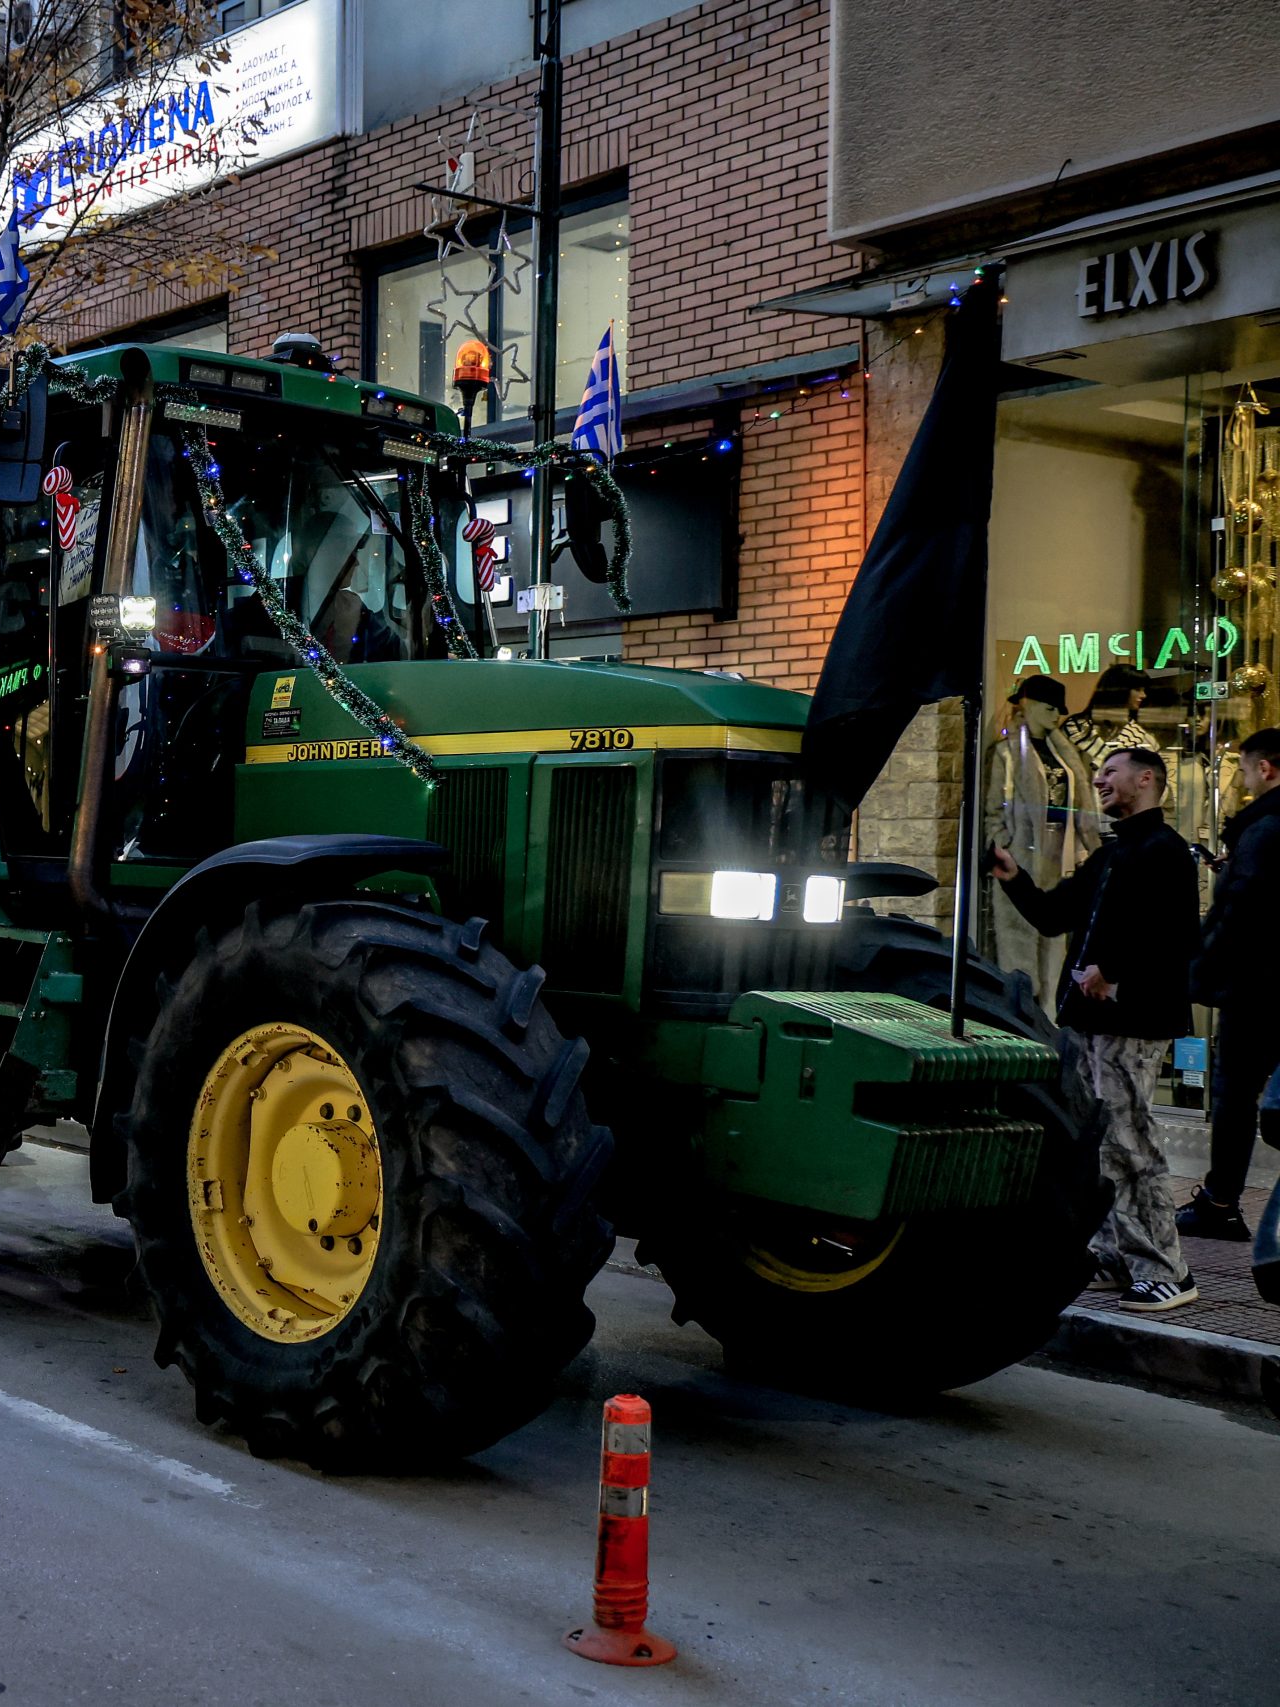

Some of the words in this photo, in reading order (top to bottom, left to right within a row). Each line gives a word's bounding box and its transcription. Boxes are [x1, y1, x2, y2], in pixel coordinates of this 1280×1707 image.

[242, 47, 278, 72] ΔΑΟΥΛΑΣ
[242, 61, 288, 90] ΚΩΣΤΟΥΛΑΣ
[1078, 230, 1207, 317] ELXIS
[570, 729, 634, 750] 7810
[287, 743, 333, 762] JOHN
